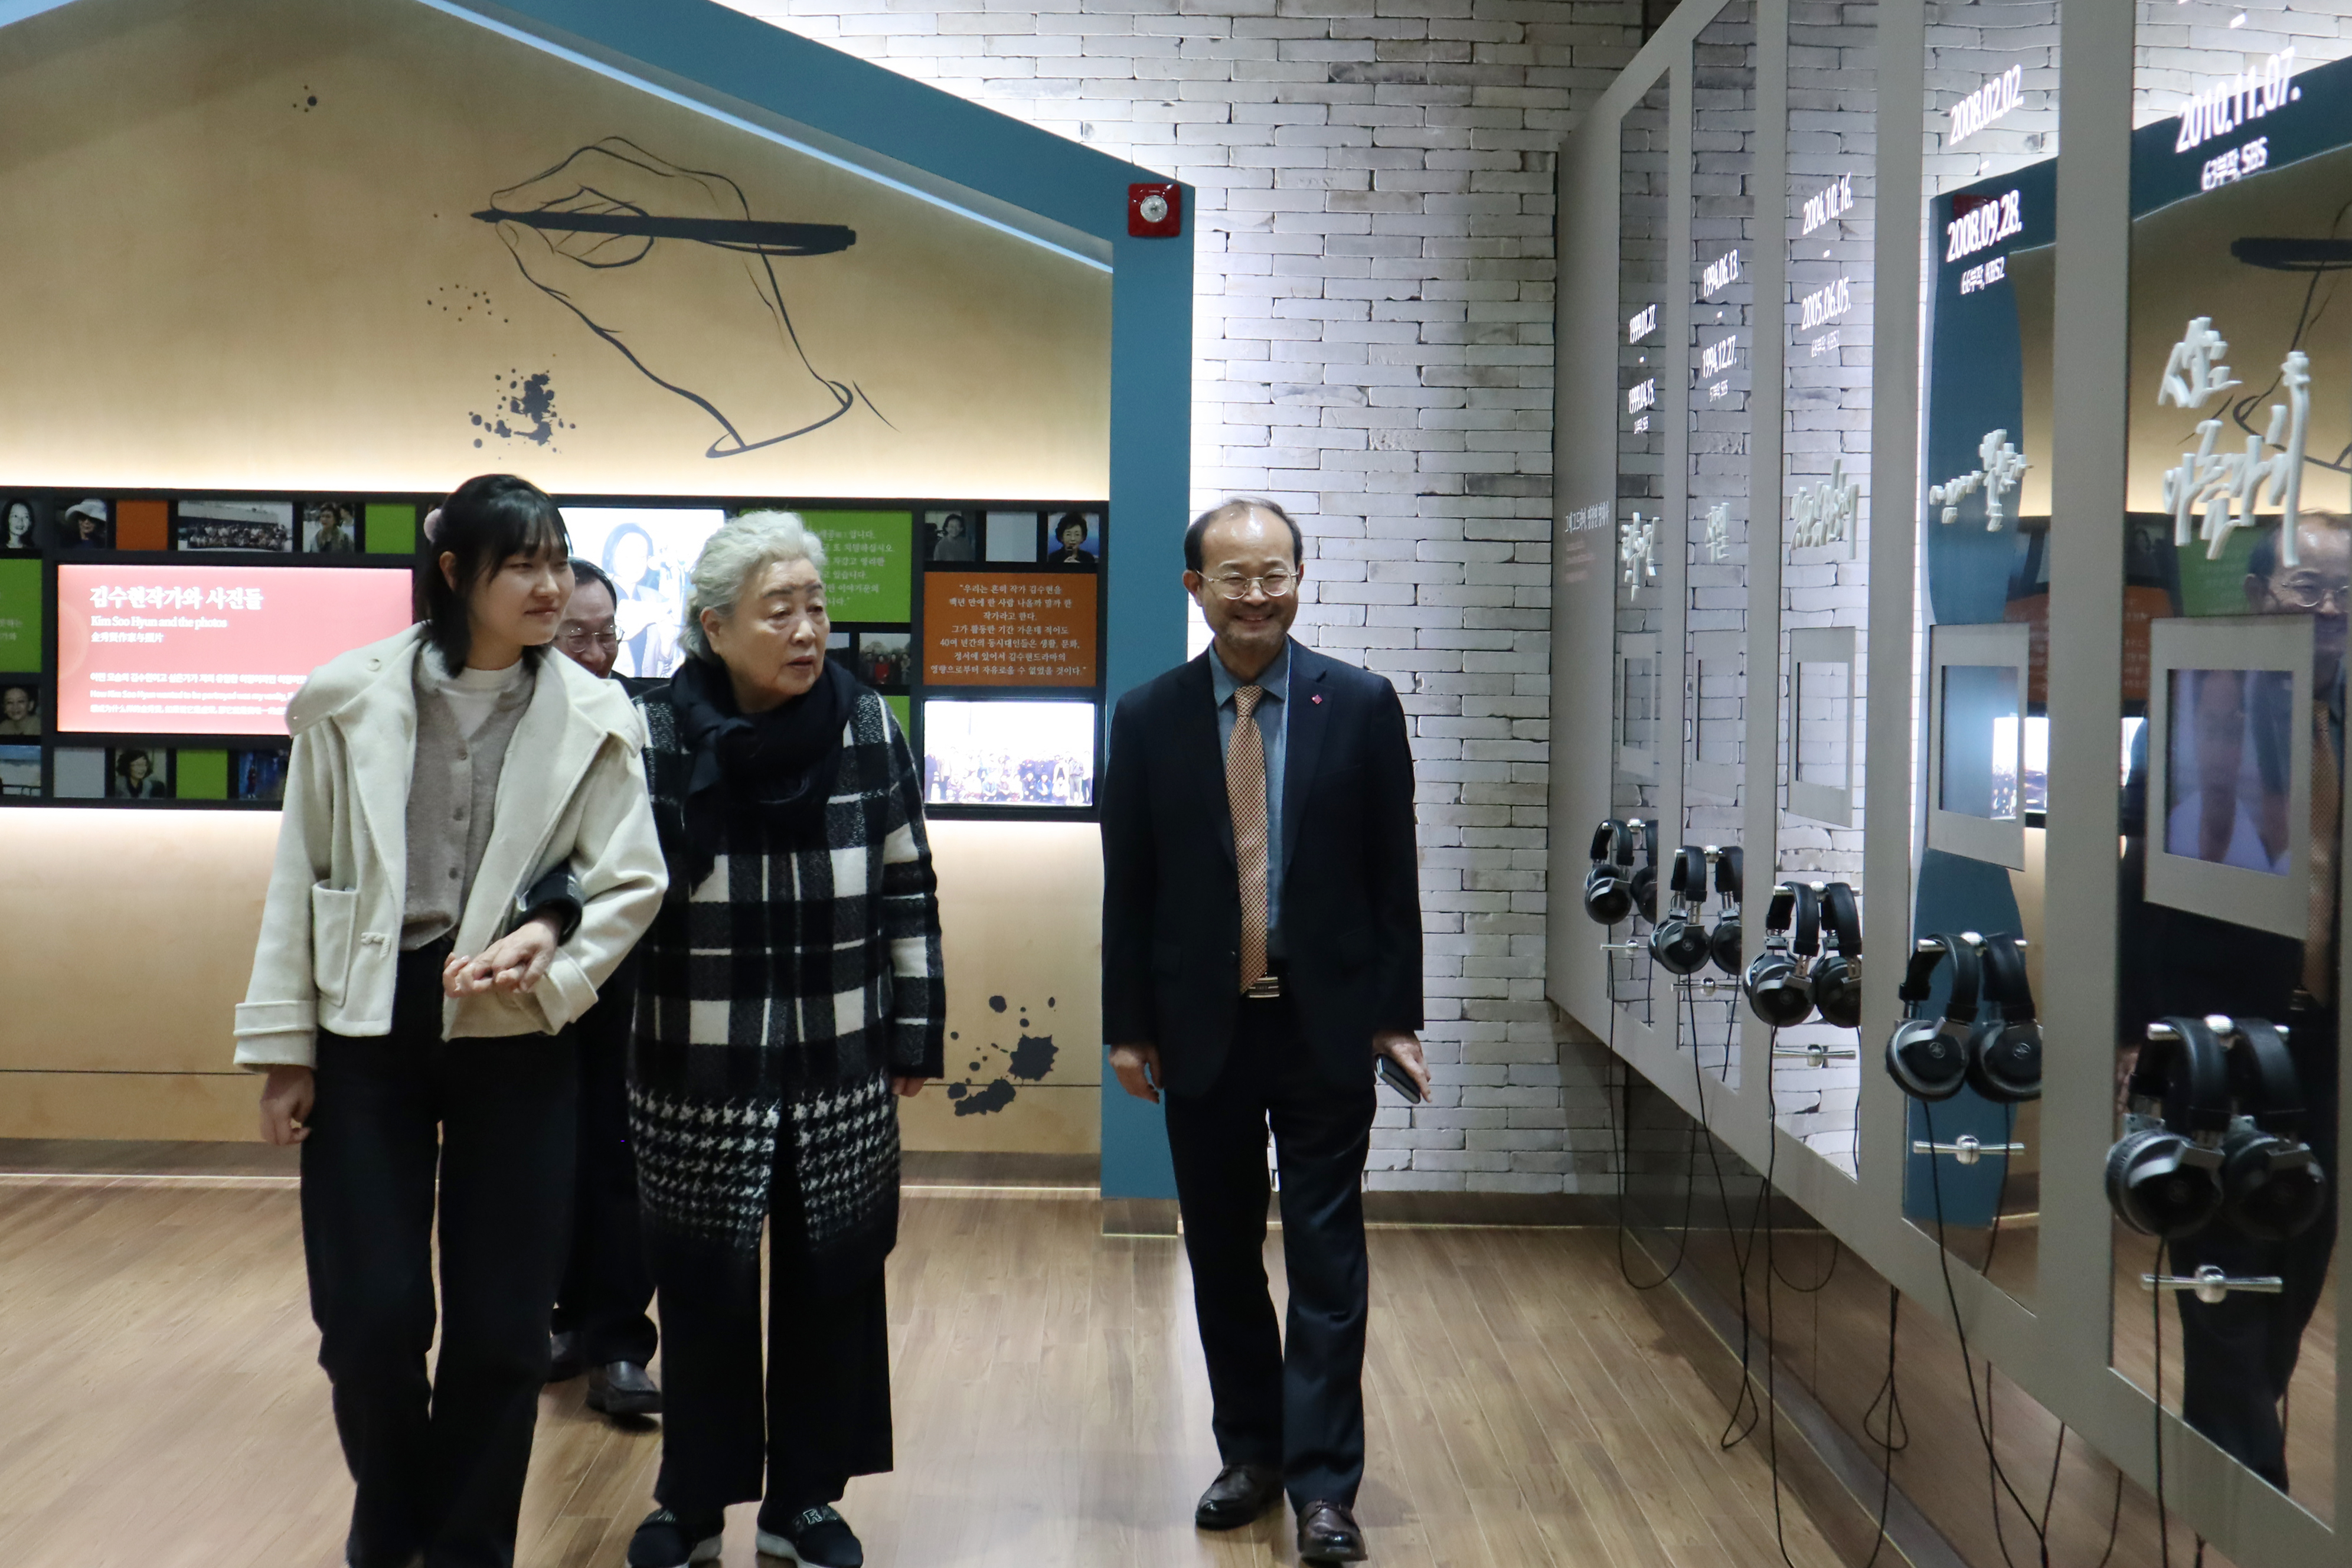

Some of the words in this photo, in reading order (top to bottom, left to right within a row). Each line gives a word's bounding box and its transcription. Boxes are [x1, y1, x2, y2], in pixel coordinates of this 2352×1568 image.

[1949, 64, 2024, 145] 2008.02.02.
[2175, 45, 2301, 153] 2010.11.07.
[2242, 136, 2268, 174] SBS
[1803, 172, 1853, 235] 2004.10.16.
[1946, 190, 2023, 262] 2008.09.28.
[1703, 249, 1739, 297] 1994.06.13.
[1985, 256, 2005, 285] KBS2
[1801, 276, 1851, 331] 2005.06.05.
[1629, 304, 1656, 344] 1999.01.27.
[1702, 335, 1737, 378] 1994.12.27.
[1628, 378, 1655, 414] 1999.04.15.
[90, 585, 204, 609] 김수현작가와
[205, 586, 264, 610] 사진들
[949, 597, 966, 607] 백년
[968, 597, 985, 607] 만에
[987, 598, 996, 607] 한
[998, 598, 1014, 607] 사람
[1018, 599, 1042, 607] 나올까
[1045, 599, 1061, 608] 말까
[1064, 599, 1072, 608] 한
[991, 584, 1008, 594] 흔히
[1010, 585, 1026, 594] 작가
[1030, 585, 1062, 594] 김수현을
[90, 615, 111, 627] Kim
[112, 616, 130, 627] Soo
[131, 616, 158, 630] Hyun
[158, 617, 177, 628] and
[178, 617, 194, 628] the
[194, 617, 227, 630] photos
[984, 611, 1015, 621] 작가라고
[1018, 612, 1037, 621] 한다.
[940, 638, 958, 648] 40여
[961, 638, 985, 648] 년간의
[988, 639, 1037, 648] 동시대인들은
[952, 625, 968, 634] 그가
[971, 625, 995, 634] 활동한
[998, 625, 1014, 634] 기간
[1018, 625, 1042, 635] 가운데
[1045, 625, 1069, 635] 적어도
[930, 665, 979, 674] 영향으로부터
[982, 665, 1015, 675] 자유로울
[1018, 666, 1025, 675] 수
[1028, 666, 1053, 675] 없었을
[955, 652, 979, 661] 정서에
[981, 652, 1006, 661] 있어서
[1009, 652, 1066, 662] 김수현드라마의
[130, 673, 167, 682] 김수현이고
[137, 691, 156, 700] Hyun
[156, 691, 183, 699] wanted
[202, 691, 236, 701] portrayed
[251, 693, 263, 701] my
